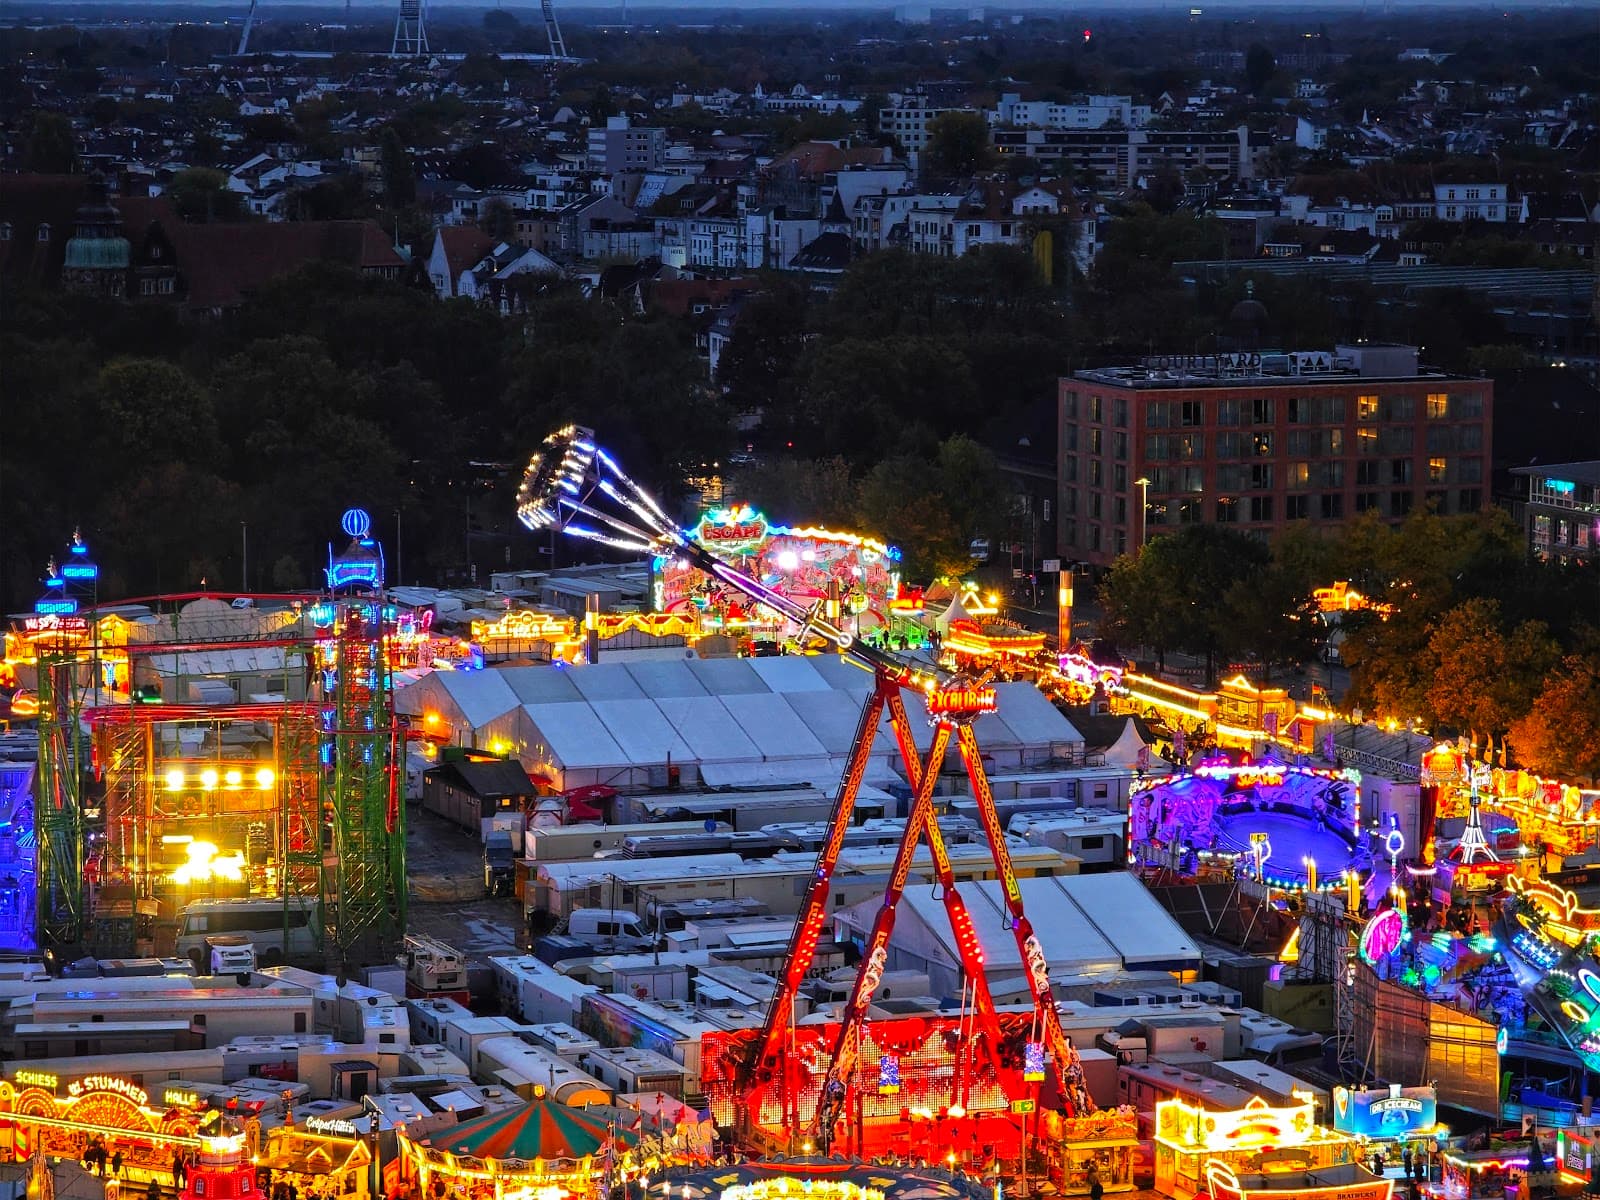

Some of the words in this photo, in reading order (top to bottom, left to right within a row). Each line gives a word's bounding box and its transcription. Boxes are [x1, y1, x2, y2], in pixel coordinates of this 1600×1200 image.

[1141, 353, 1262, 369] COURTYARD
[702, 522, 761, 540] ESCAPE
[928, 689, 995, 709] EXCALIBUR
[15, 1070, 58, 1088] SCHIESS
[83, 1076, 148, 1105] STUMMER
[164, 1089, 198, 1106] HALLE
[1371, 1103, 1384, 1113] DR.
[1384, 1100, 1420, 1110] ICECREAM
